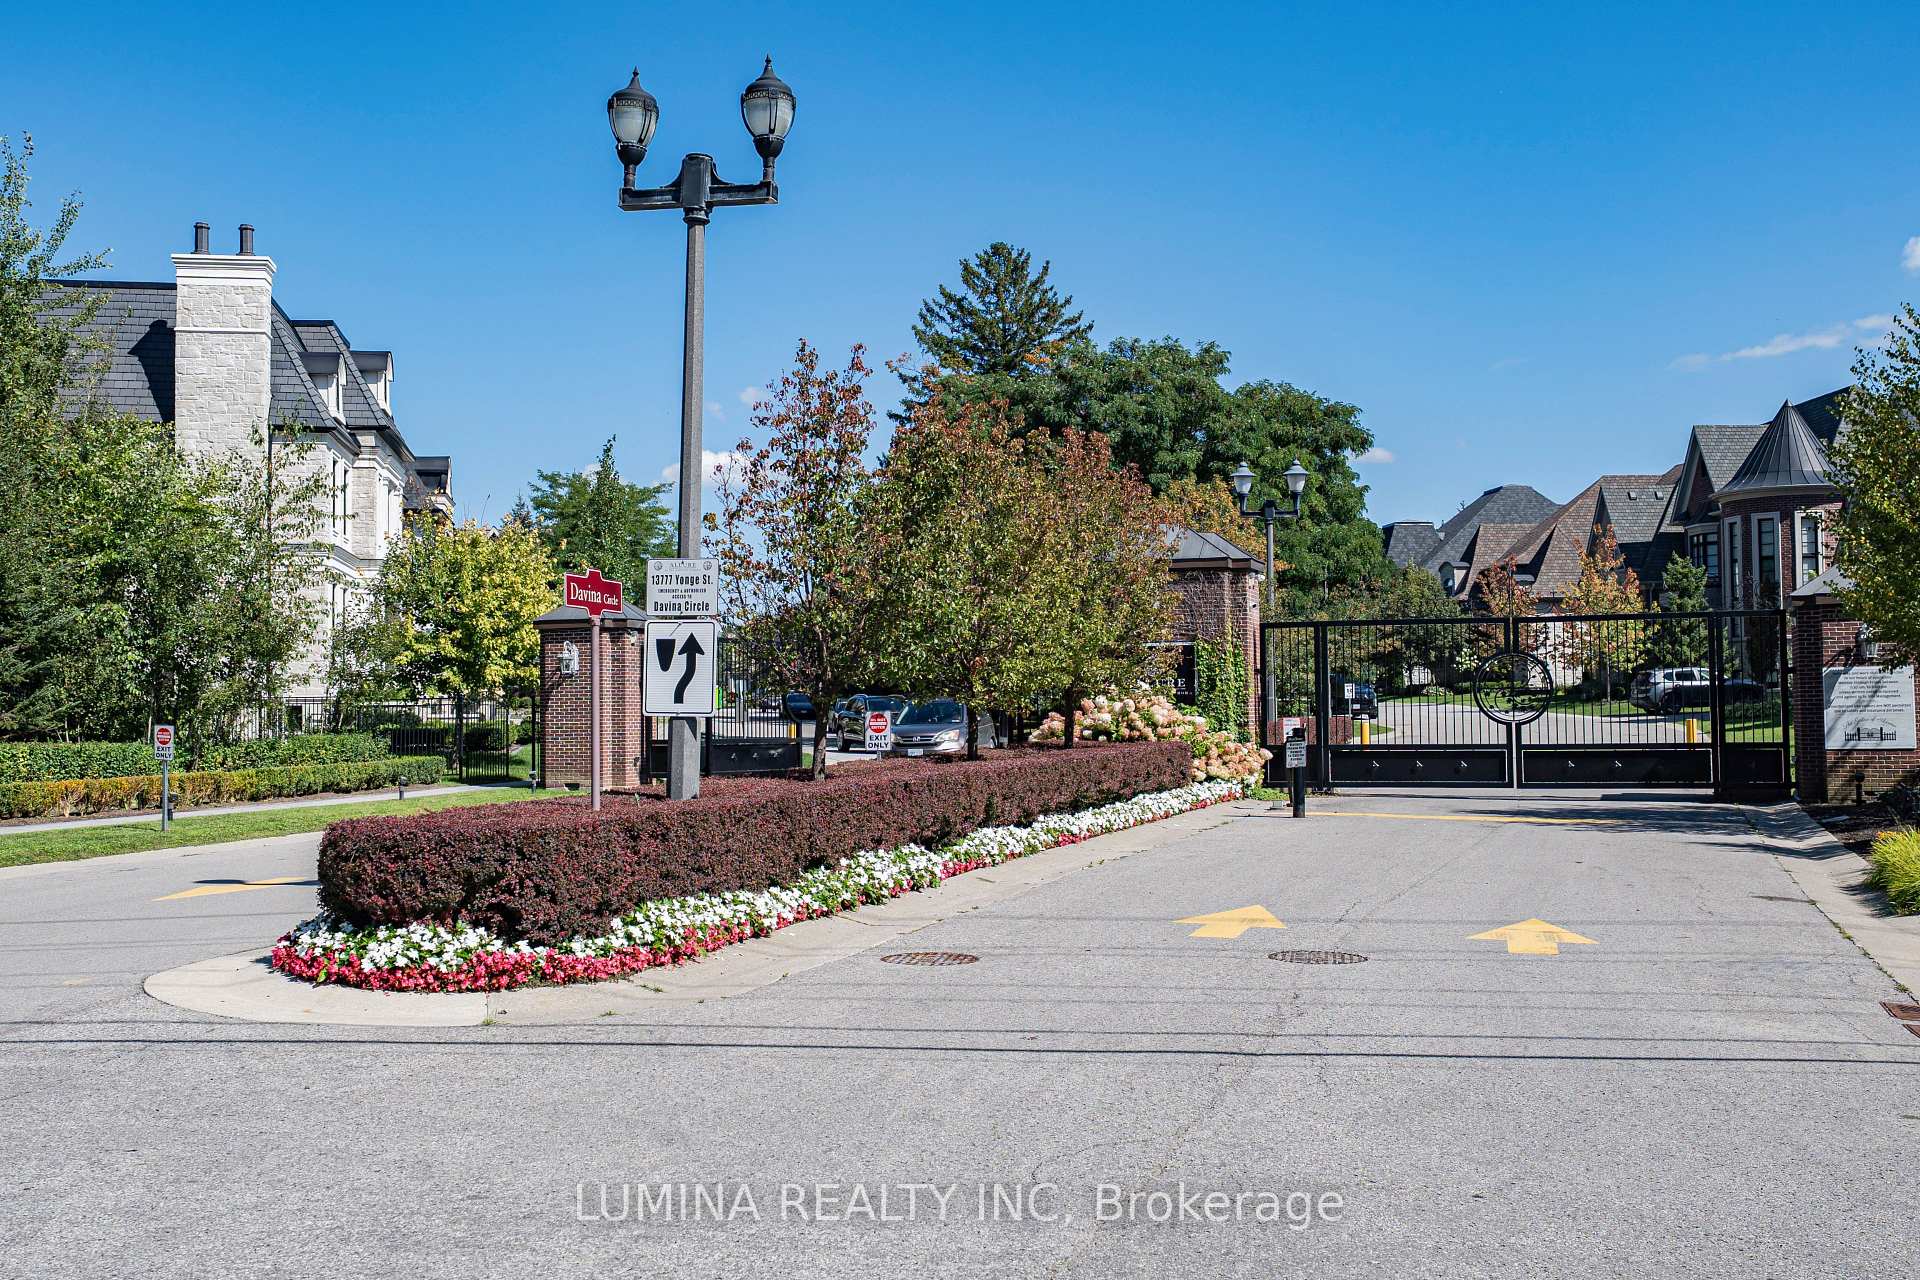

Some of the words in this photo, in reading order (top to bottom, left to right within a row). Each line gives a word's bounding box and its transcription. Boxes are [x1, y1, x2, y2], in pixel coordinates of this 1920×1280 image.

[651, 574, 673, 585] 13777
[675, 574, 700, 586] Yonge
[702, 574, 714, 585] St.
[570, 582, 602, 604] Davina
[603, 593, 619, 606] Circle
[654, 601, 682, 612] Davina
[684, 600, 710, 612] Circle
